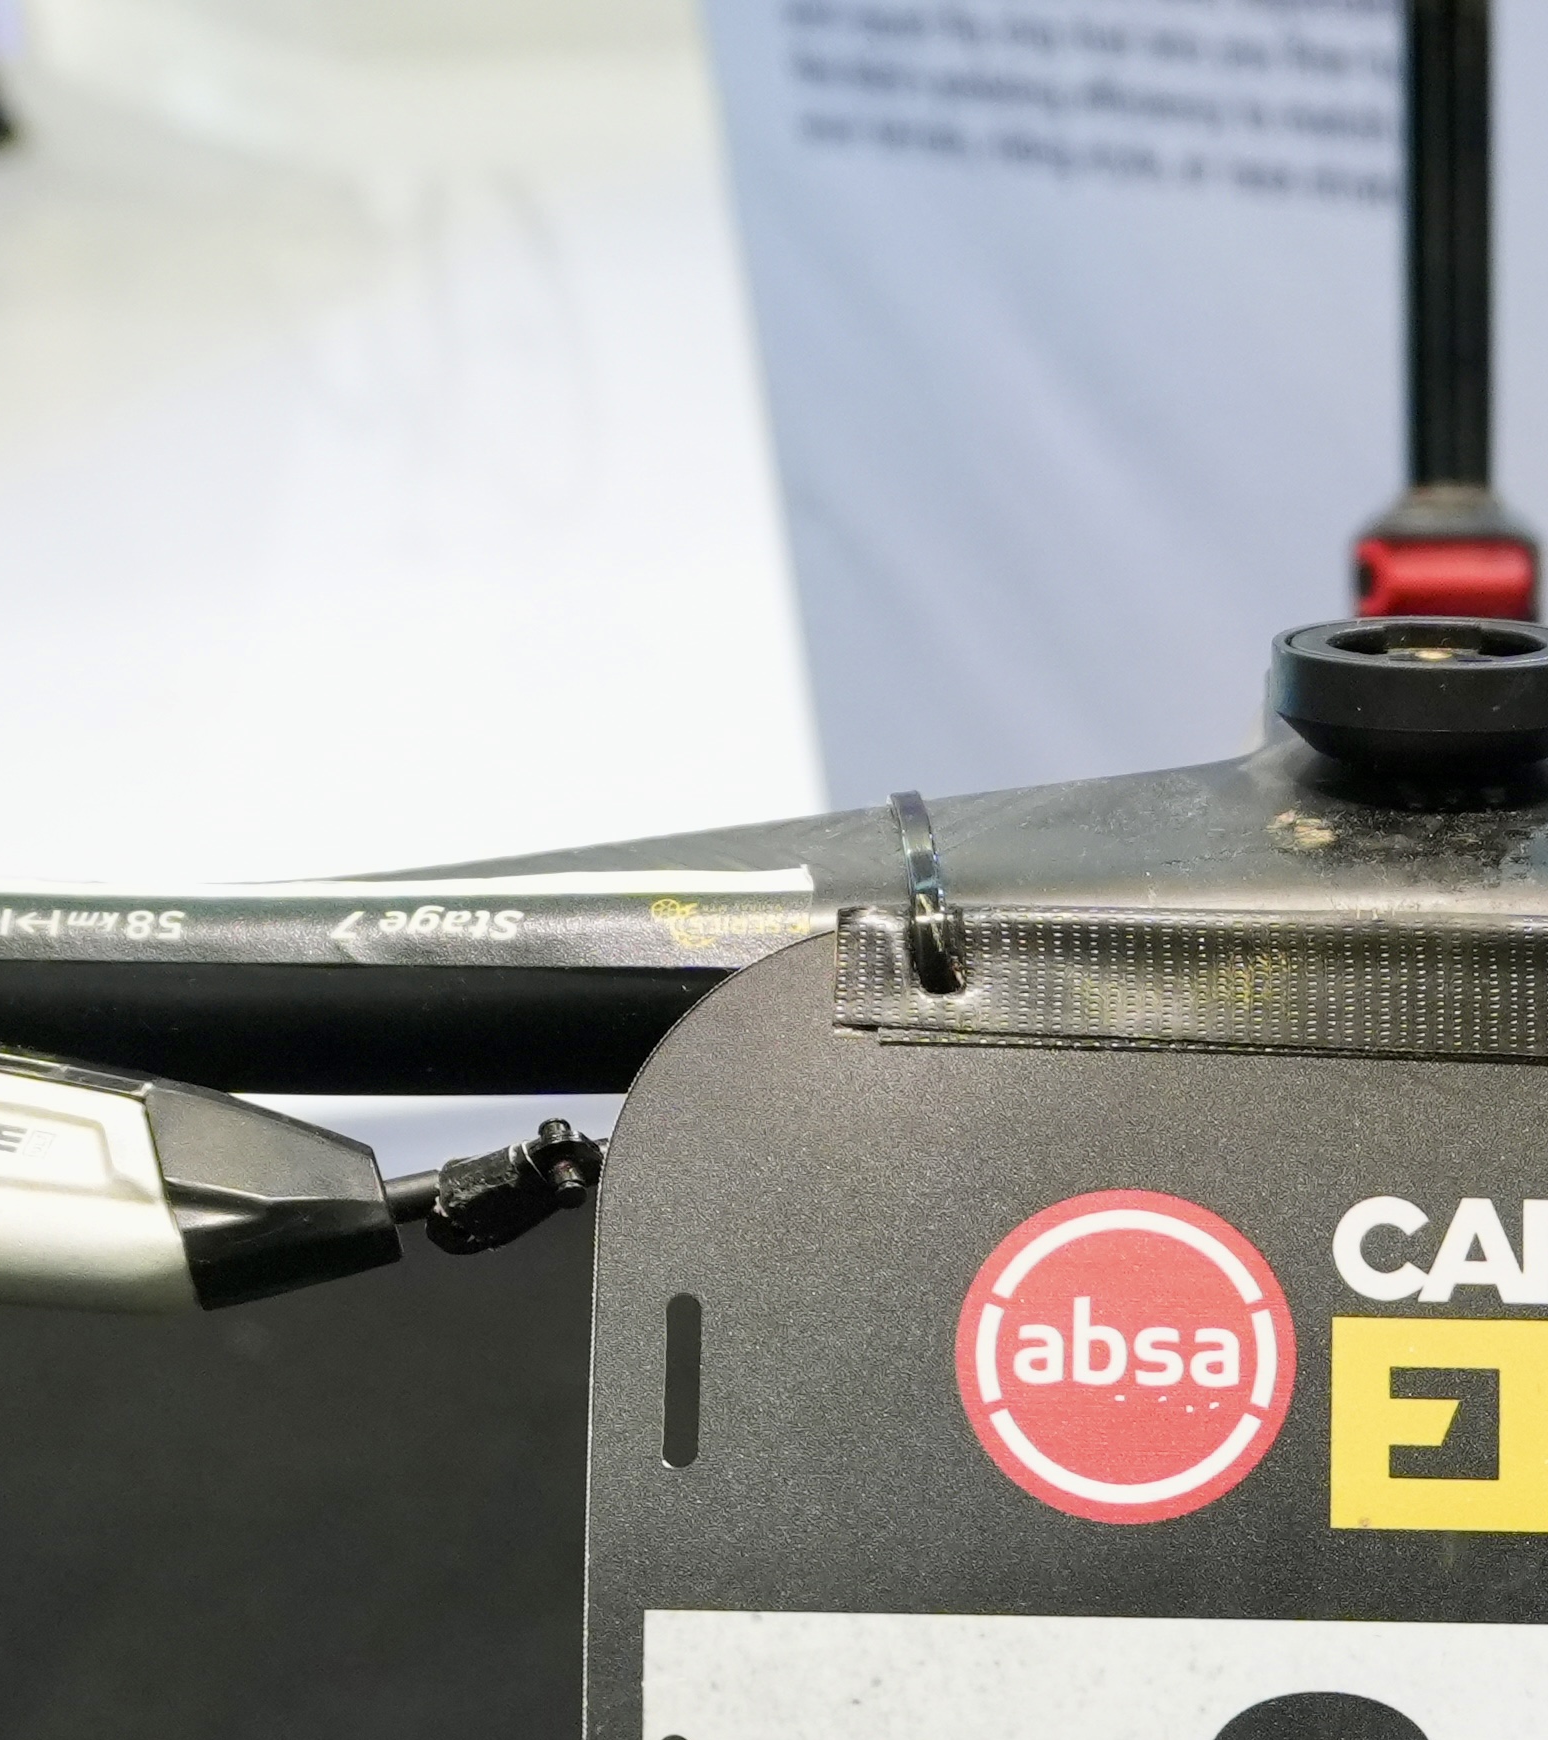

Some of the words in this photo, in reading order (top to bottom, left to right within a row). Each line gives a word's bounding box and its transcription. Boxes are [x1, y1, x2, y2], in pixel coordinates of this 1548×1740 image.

[67, 909, 120, 932] km
[127, 909, 185, 941] 58
[330, 909, 364, 941] 7
[379, 905, 524, 941] Stage
[1014, 1298, 1242, 1389] absa
